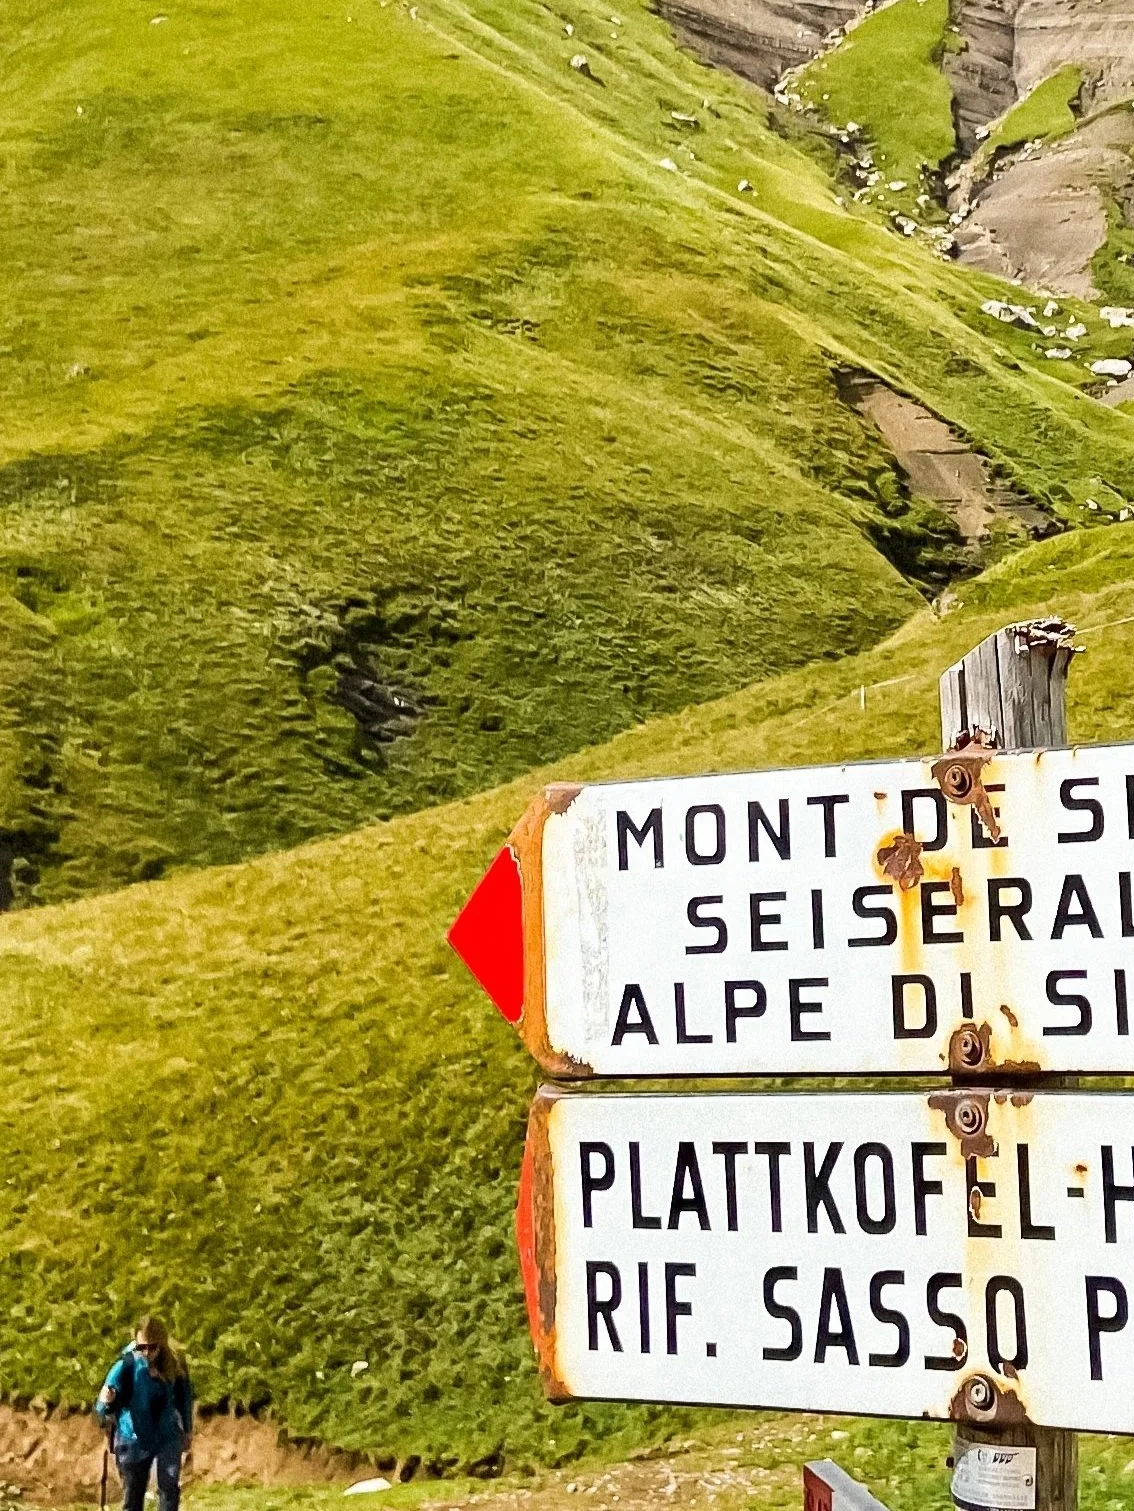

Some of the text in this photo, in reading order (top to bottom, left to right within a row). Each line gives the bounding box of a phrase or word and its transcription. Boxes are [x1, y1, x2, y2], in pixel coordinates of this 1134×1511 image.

[616, 794, 850, 871] MONT
[900, 783, 1010, 852] DE
[610, 976, 832, 1047] ALPE
[891, 972, 976, 1041] DI
[585, 1260, 717, 1358] RIF.
[762, 1265, 1029, 1374] SASSO
